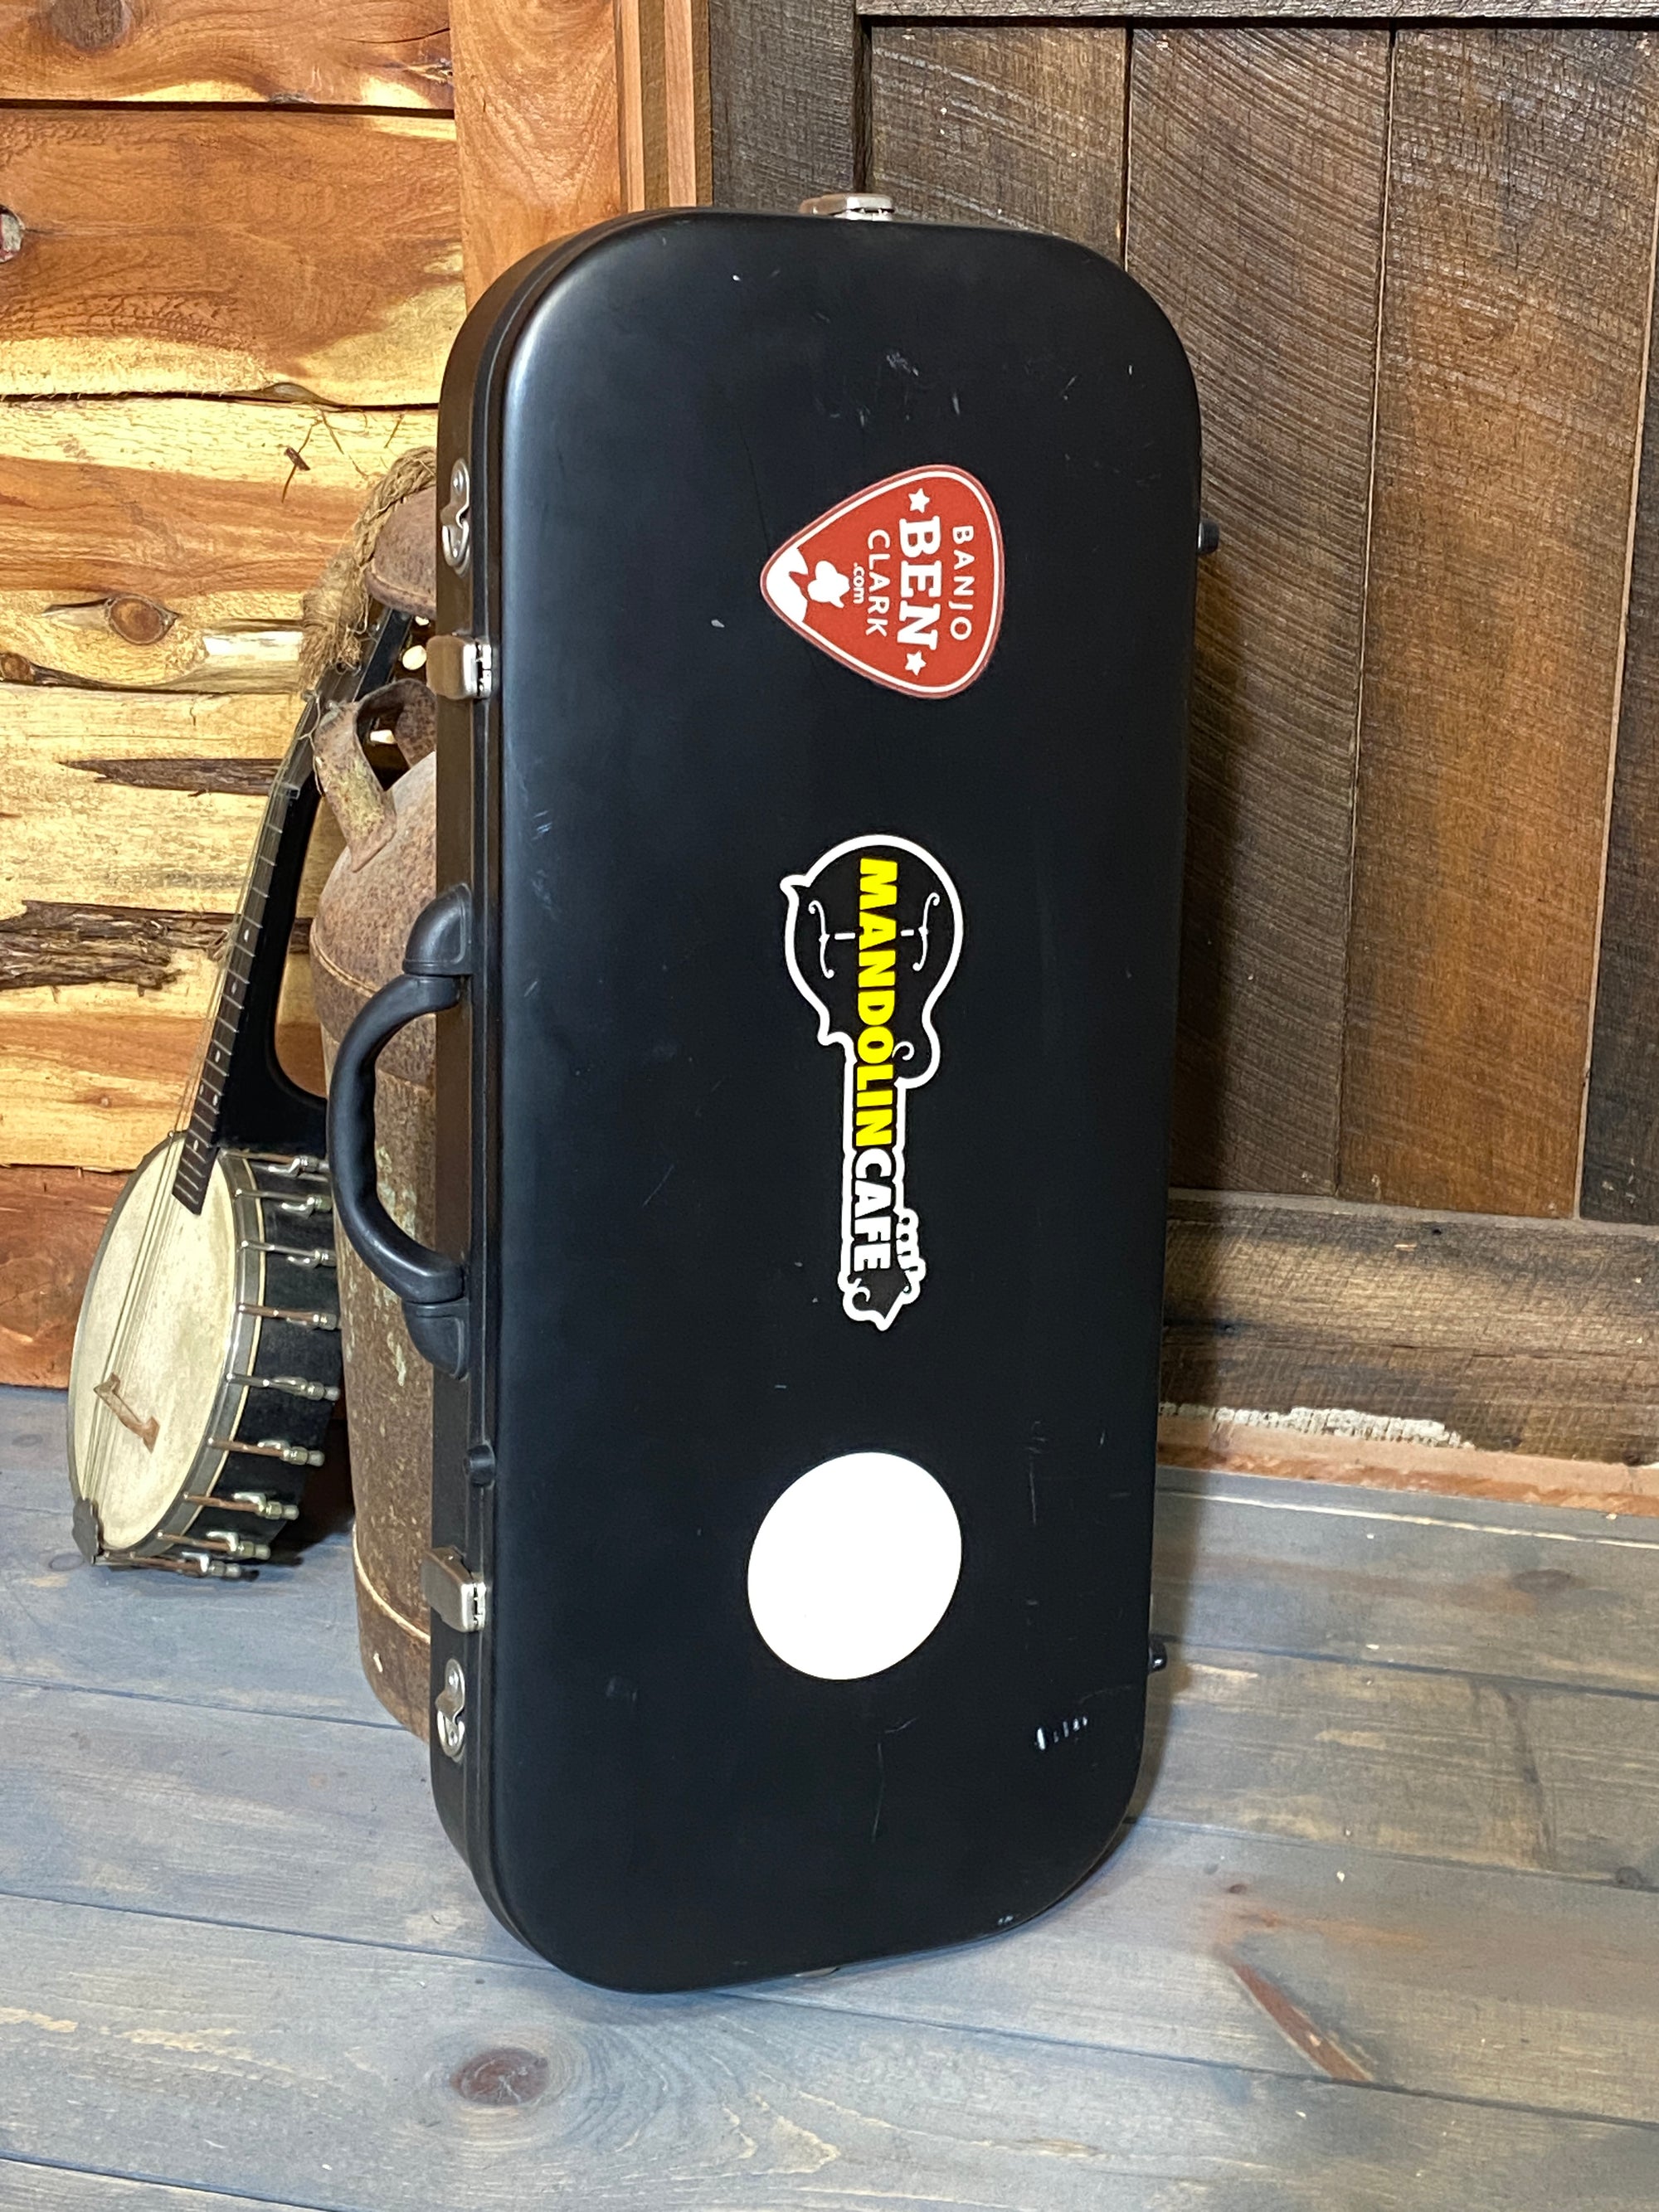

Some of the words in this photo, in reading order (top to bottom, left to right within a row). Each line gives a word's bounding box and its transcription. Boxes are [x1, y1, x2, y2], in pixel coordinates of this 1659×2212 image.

[853, 562, 865, 604] .com
[865, 529, 891, 637] CLARK
[897, 515, 942, 650] BEN
[948, 525, 975, 640] BANJO
